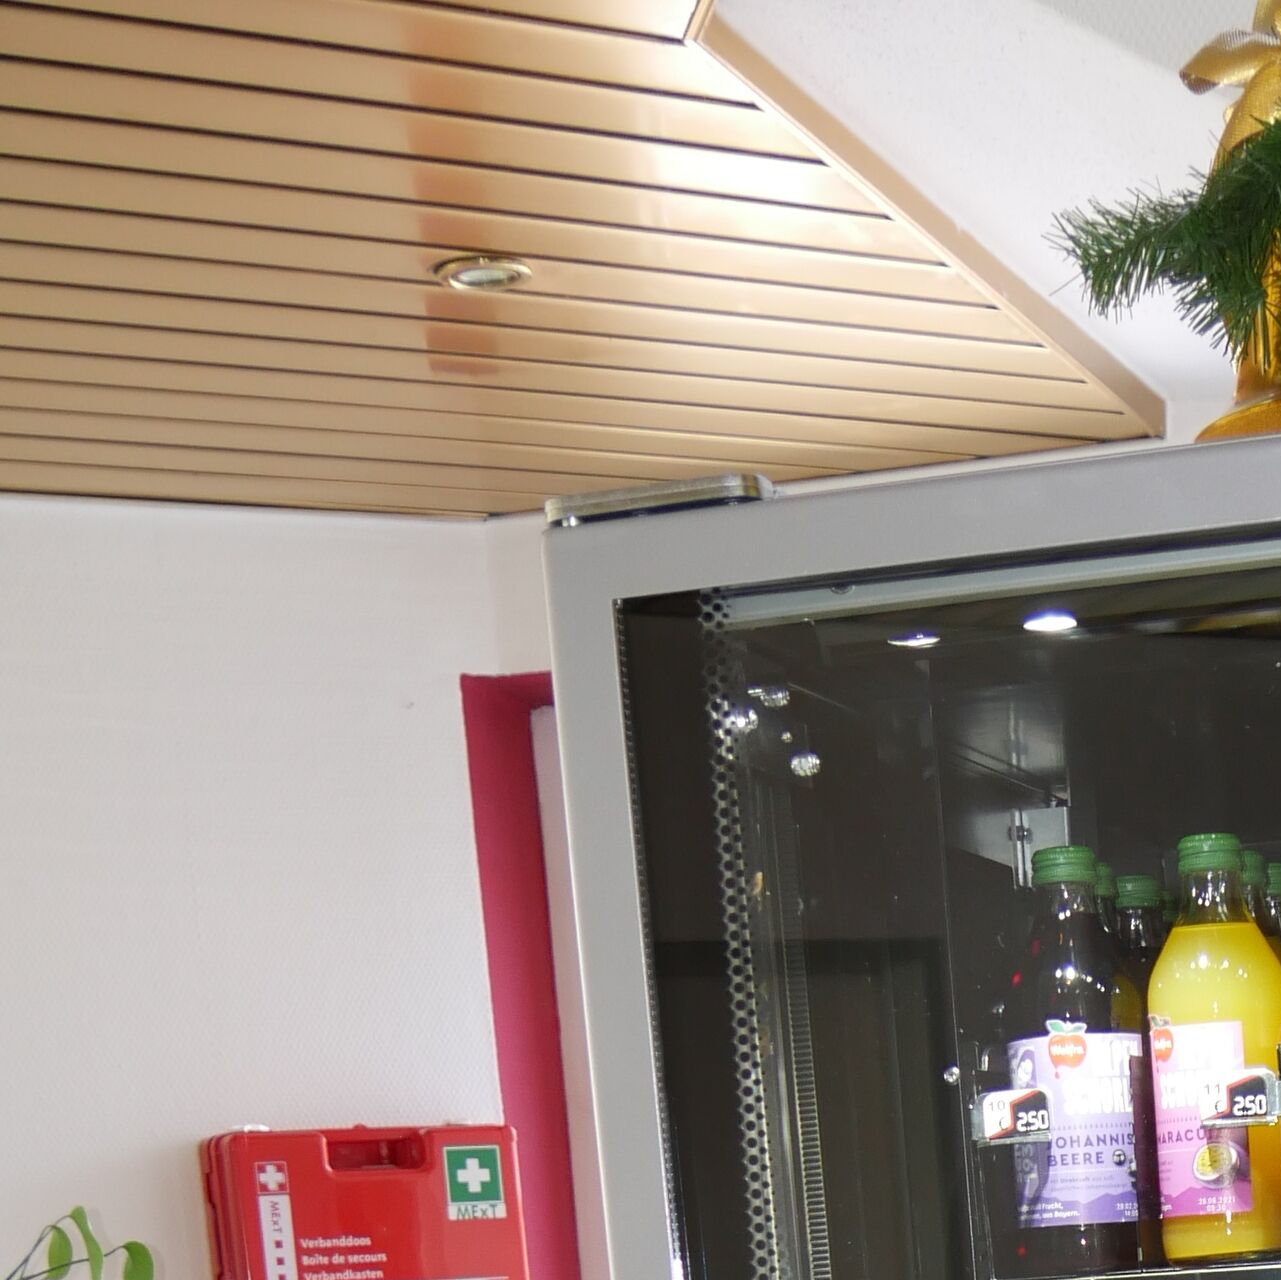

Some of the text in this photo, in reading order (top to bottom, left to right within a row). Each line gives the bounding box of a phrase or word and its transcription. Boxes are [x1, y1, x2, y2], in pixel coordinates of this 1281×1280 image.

[1048, 1152, 1104, 1166] BEERE
[269, 1201, 283, 1234] MExT
[456, 1204, 498, 1220] MExT
[300, 1236, 371, 1249] Verbanddoos
[332, 1252, 346, 1264] de
[348, 1252, 387, 1263] secours
